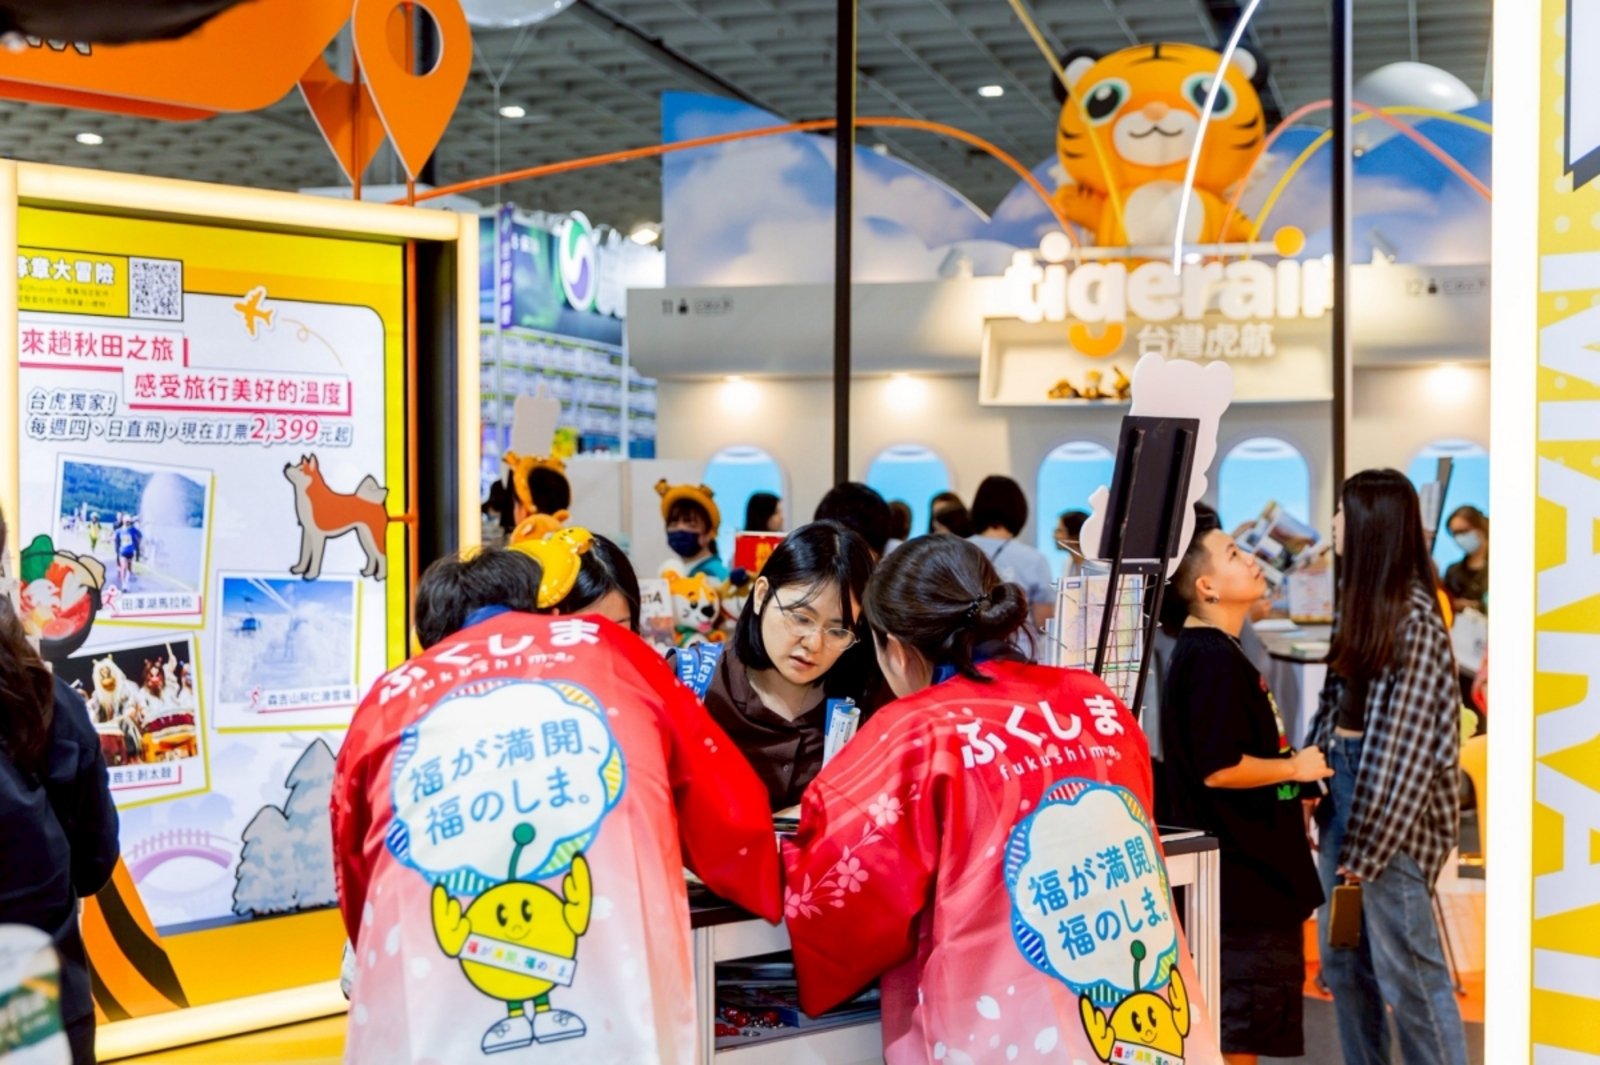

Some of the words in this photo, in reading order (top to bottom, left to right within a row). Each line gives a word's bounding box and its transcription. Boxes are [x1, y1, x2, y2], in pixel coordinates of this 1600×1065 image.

[1005, 226, 1334, 357] tigerair
[21, 327, 175, 362] 來趟秋田之旅
[1136, 322, 1276, 358] 台灣虎航
[379, 618, 600, 706] ふくしま
[408, 718, 601, 803] 福が満開、
[956, 694, 1125, 769] ふくしま
[999, 744, 1117, 781] fukushima
[425, 766, 591, 845] 福のしま。
[1028, 835, 1157, 916] 福が満開、
[1058, 887, 1169, 961] 福のしま。
